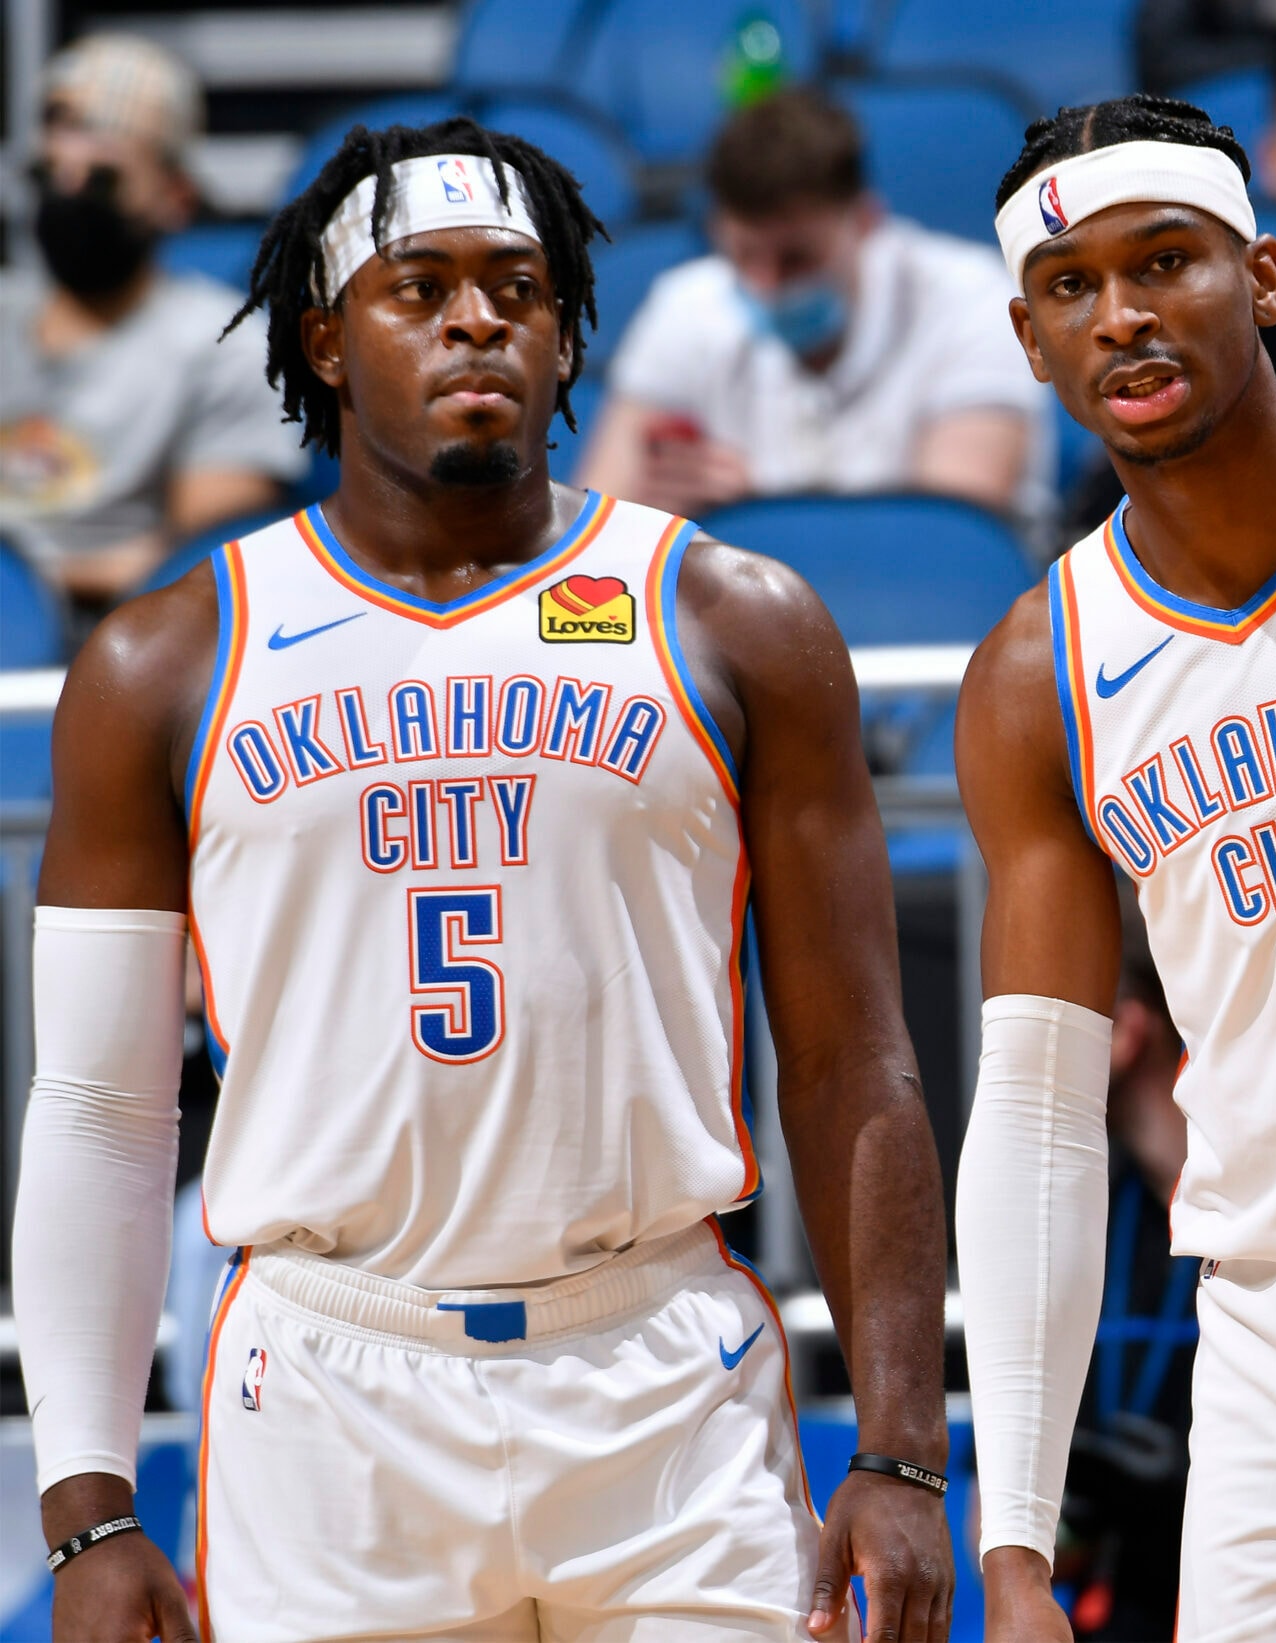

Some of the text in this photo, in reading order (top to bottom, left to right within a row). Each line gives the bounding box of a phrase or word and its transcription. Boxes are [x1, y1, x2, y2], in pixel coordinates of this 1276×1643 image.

[226, 673, 667, 805] OKLAHOMA
[360, 773, 537, 874] CITY
[407, 884, 505, 1066] 5
